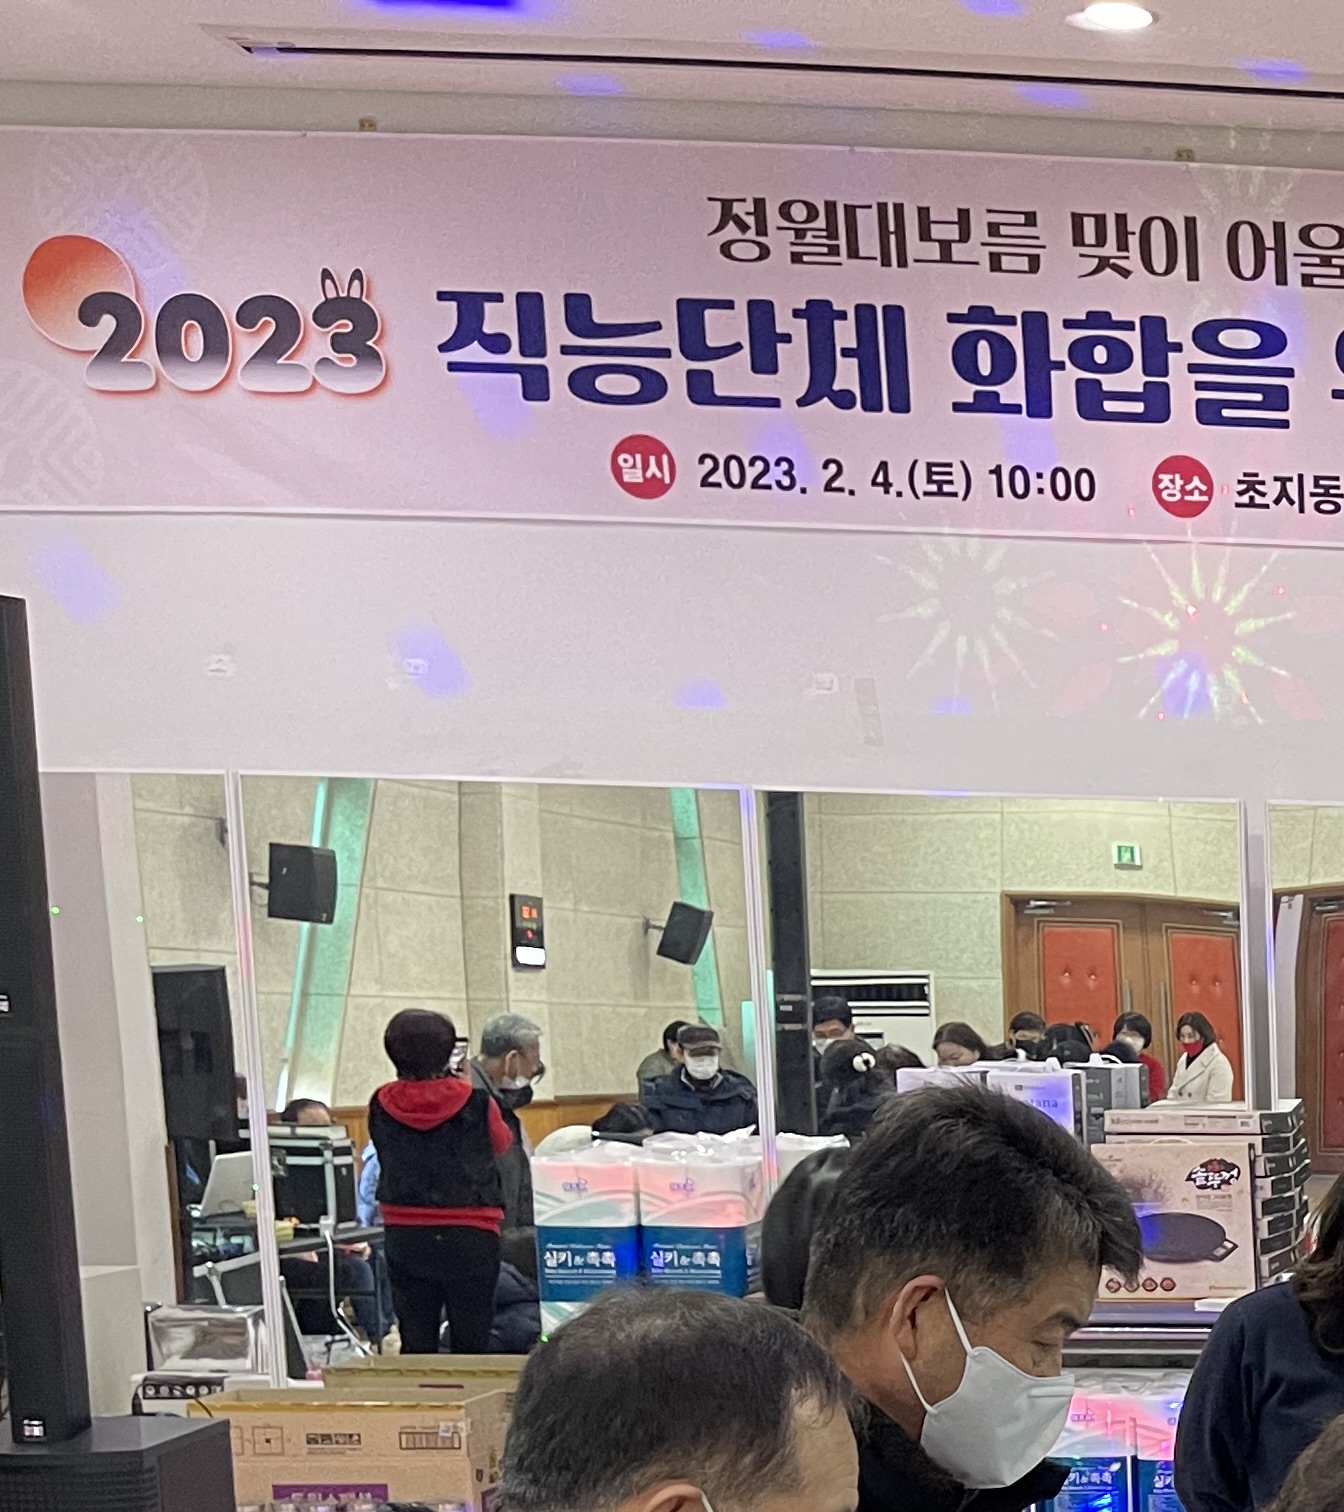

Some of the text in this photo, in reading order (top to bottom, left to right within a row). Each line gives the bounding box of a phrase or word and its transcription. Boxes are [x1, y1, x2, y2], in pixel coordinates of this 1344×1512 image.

[707, 194, 1047, 278] 정월대보름
[1072, 210, 1201, 282] 맞이
[77, 290, 388, 394] 2023
[436, 290, 911, 416] 직능단체
[946, 304, 1296, 432] 화합을
[617, 451, 1097, 504] 일시 2023. 2. 4.(토) 10:00
[1158, 471, 1212, 505] 장소
